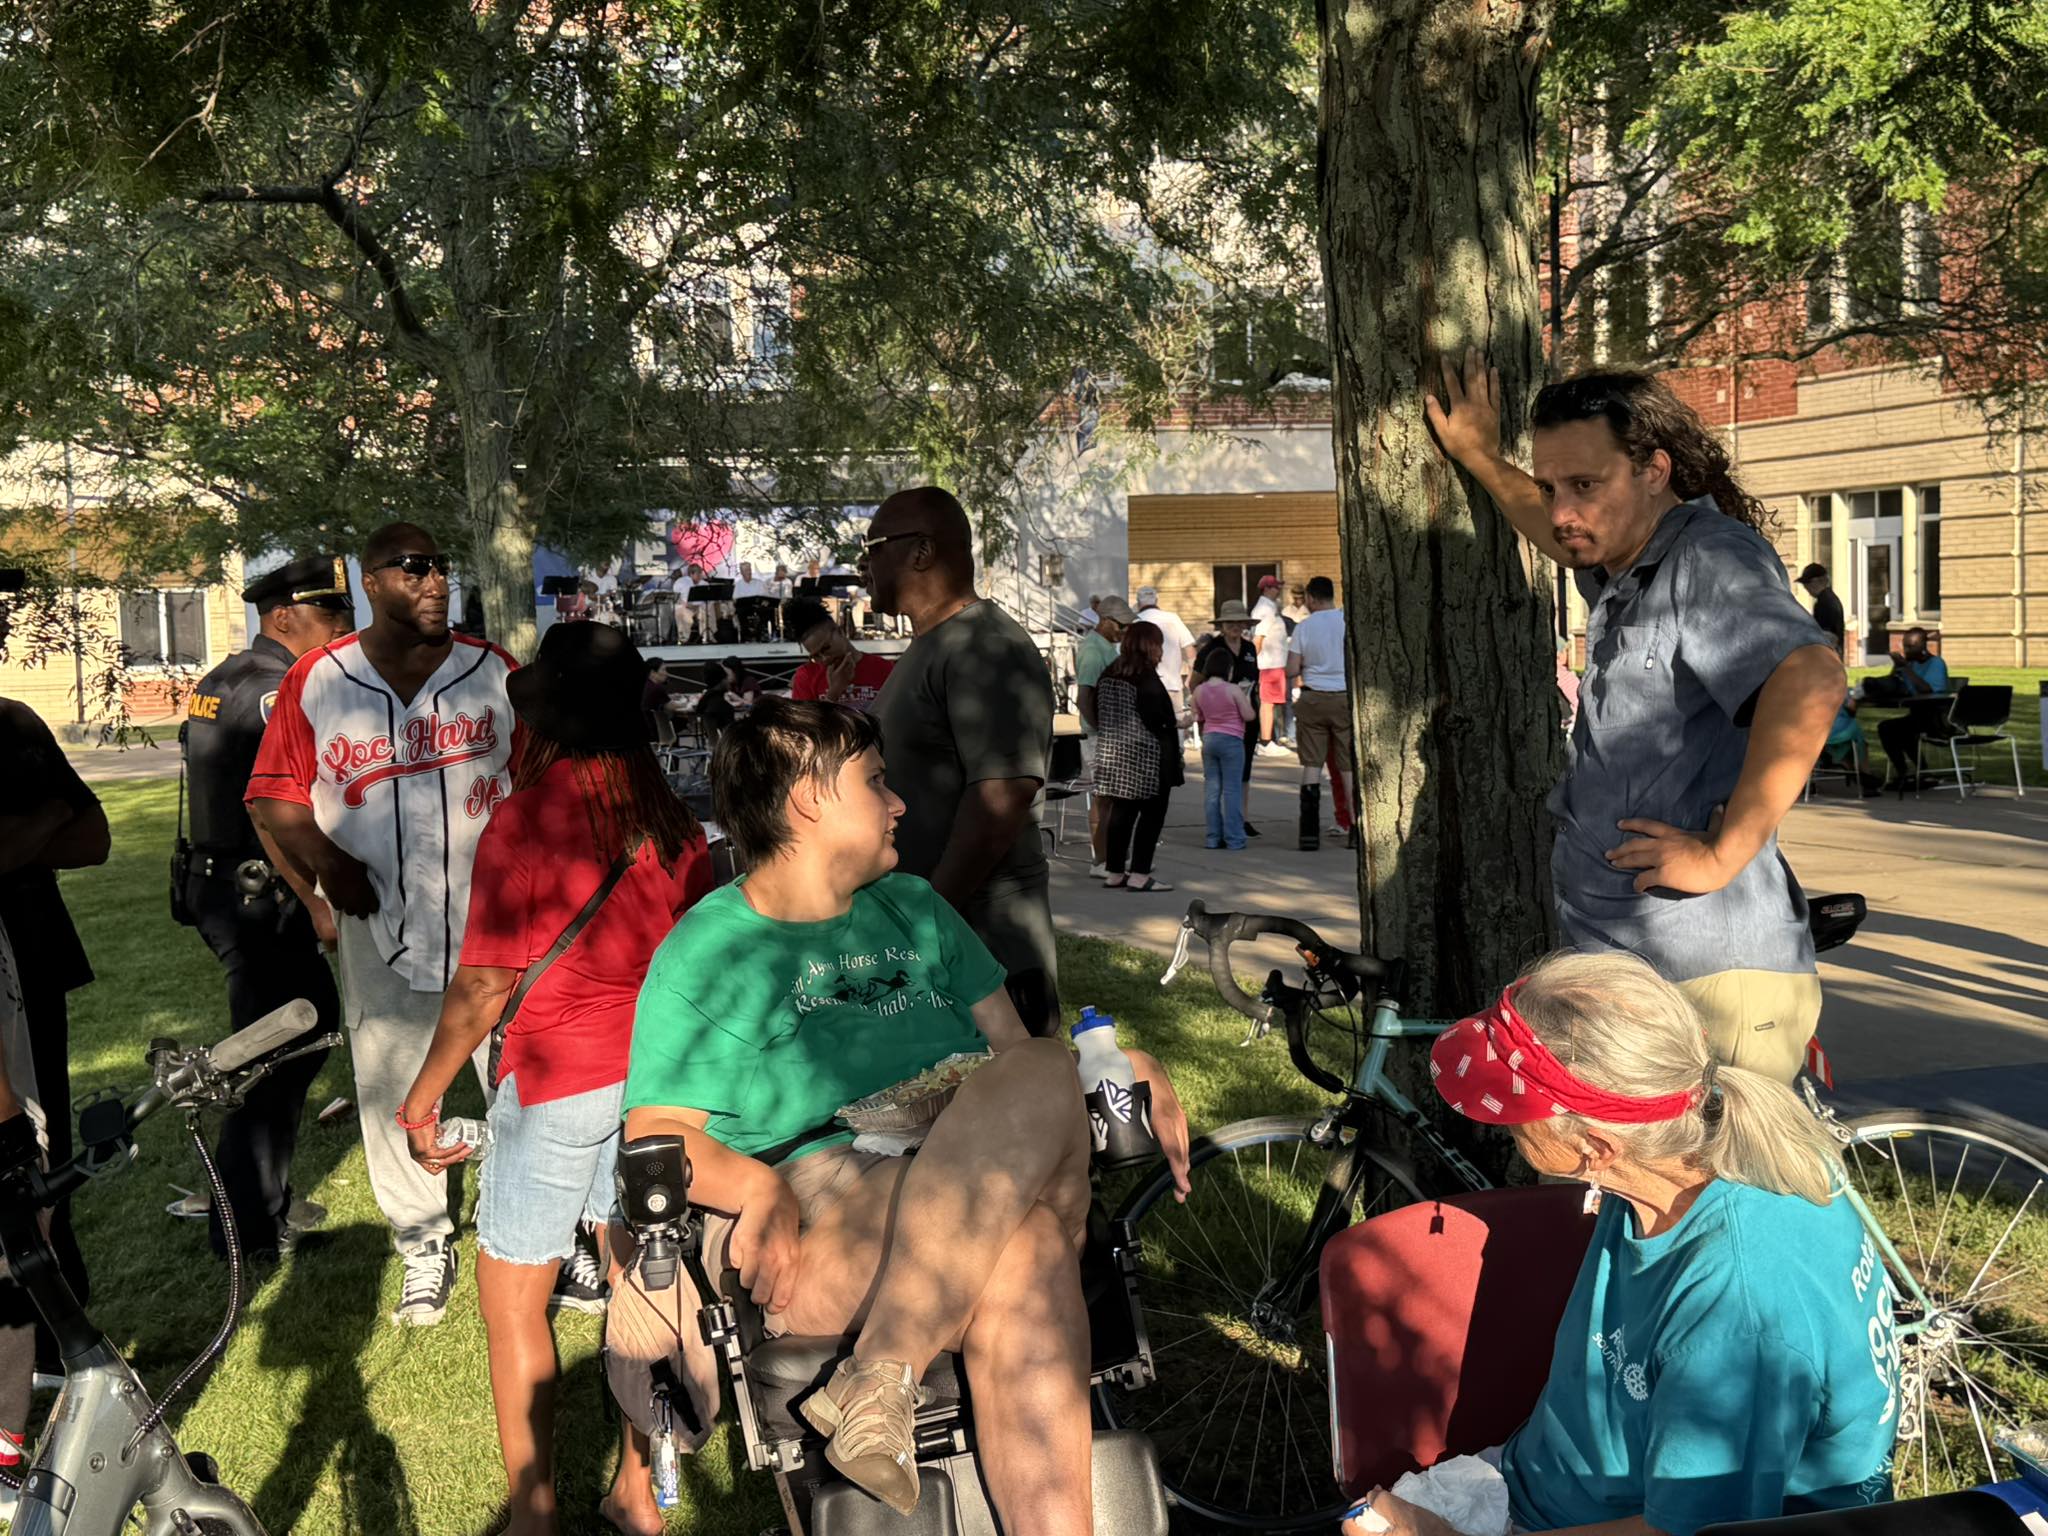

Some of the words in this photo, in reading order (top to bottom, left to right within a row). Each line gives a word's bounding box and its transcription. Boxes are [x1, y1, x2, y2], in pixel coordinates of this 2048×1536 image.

[188, 692, 221, 720] OLICE
[321, 732, 396, 785] Roc
[399, 705, 498, 763] Hard
[838, 953, 878, 970] Horse
[884, 946, 921, 962] Resc
[1852, 1231, 1876, 1303] Rota
